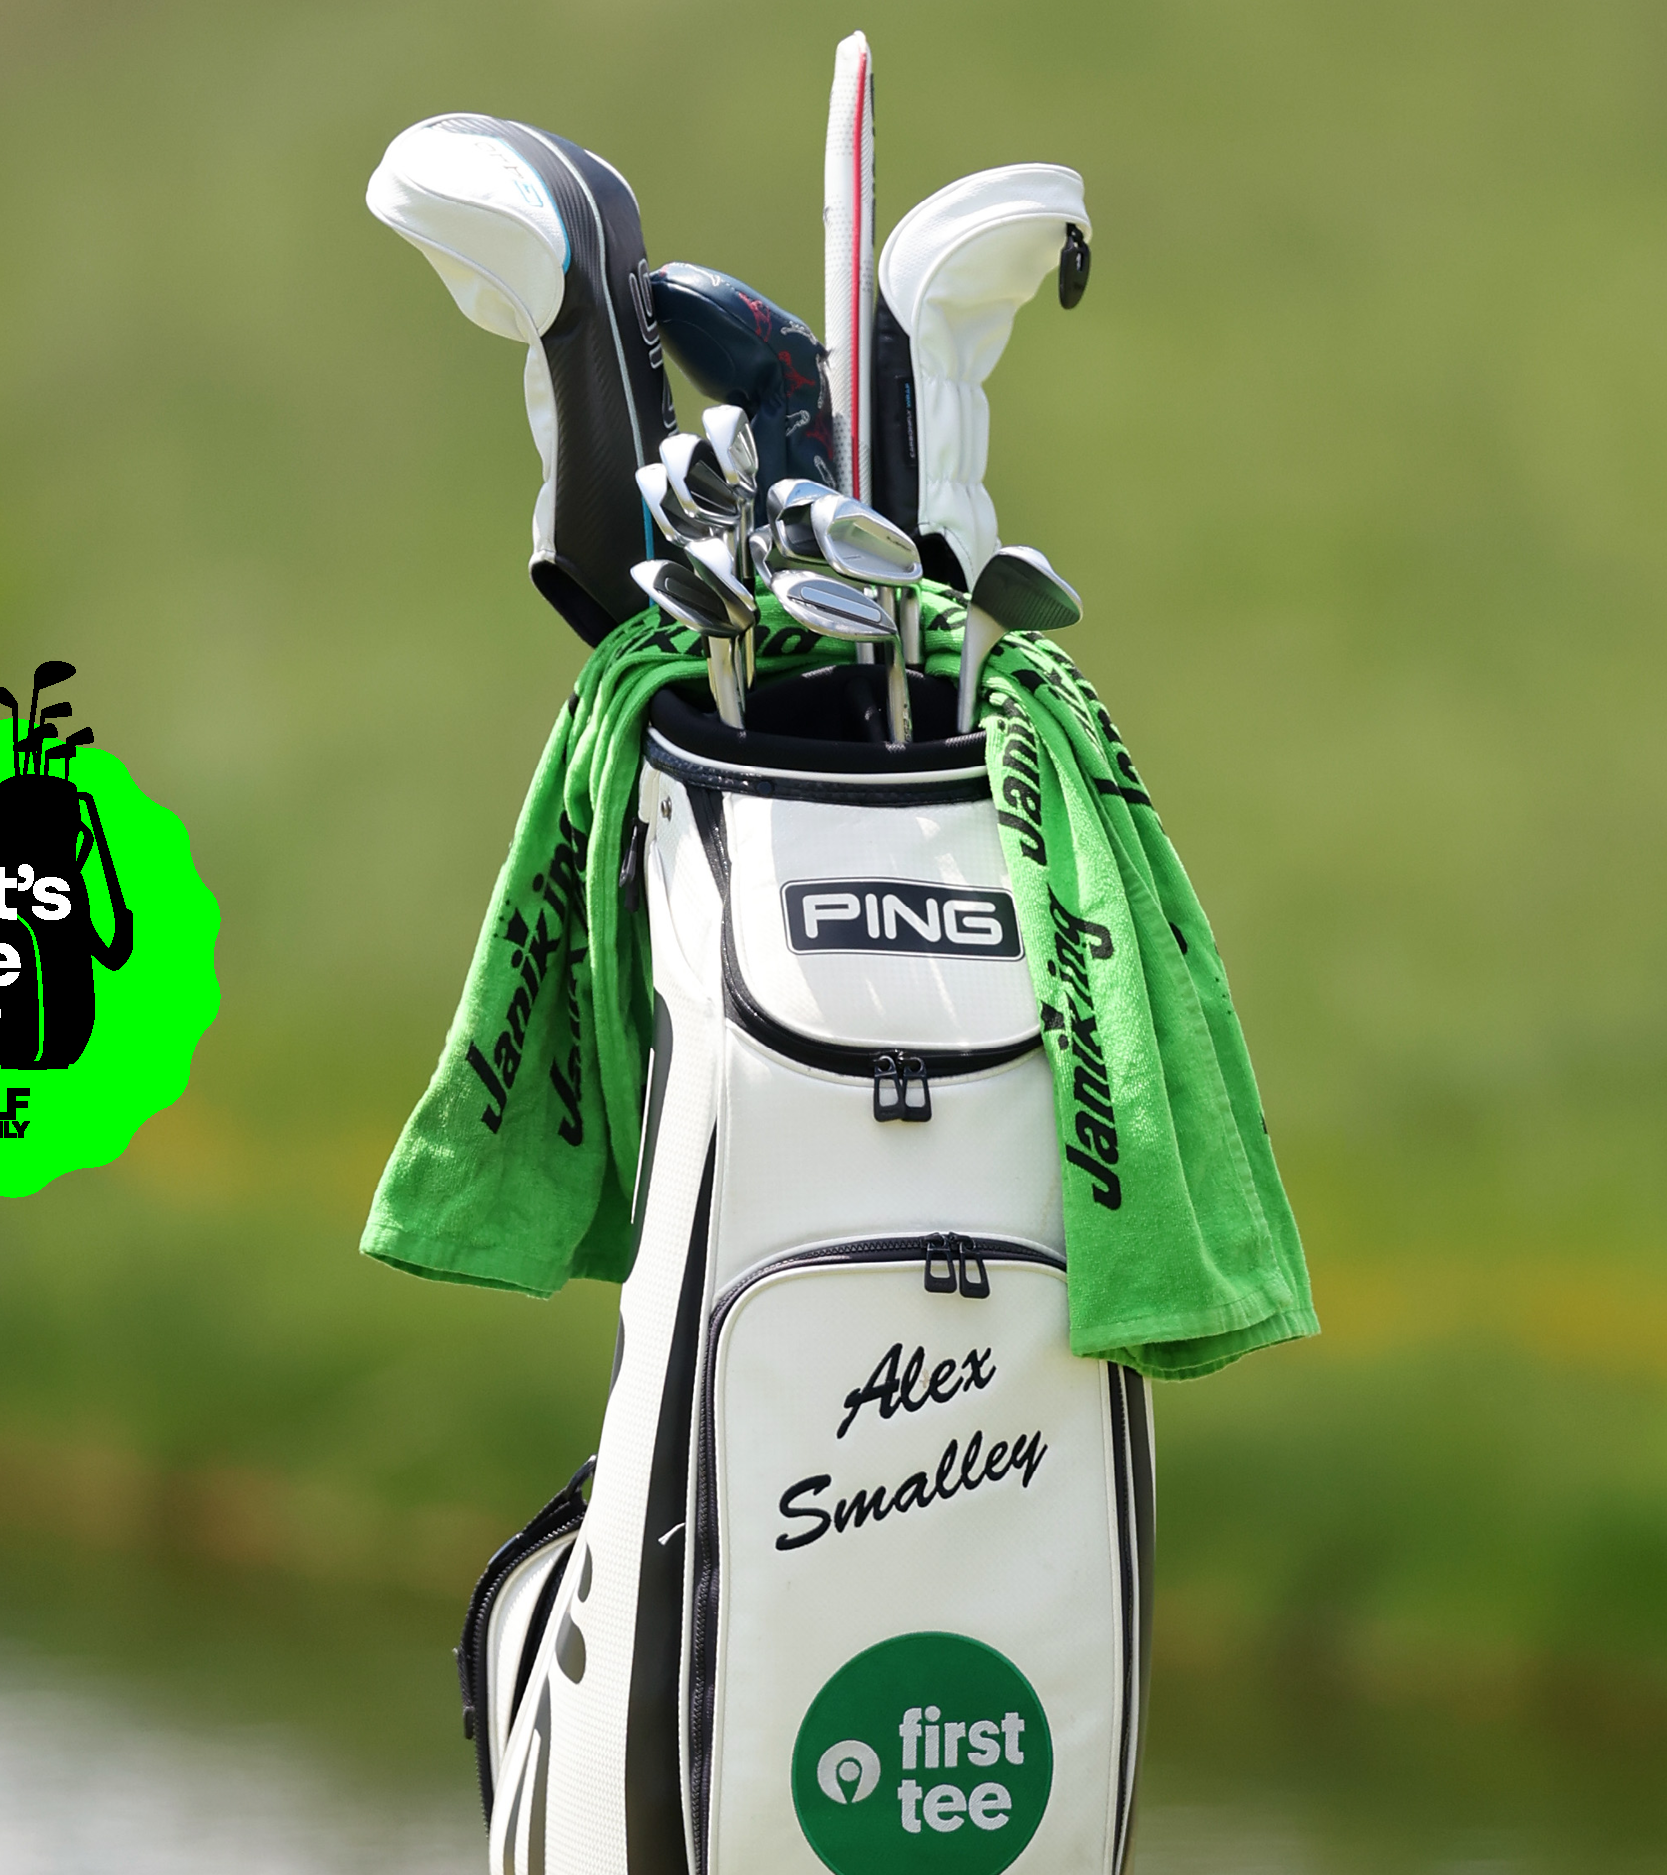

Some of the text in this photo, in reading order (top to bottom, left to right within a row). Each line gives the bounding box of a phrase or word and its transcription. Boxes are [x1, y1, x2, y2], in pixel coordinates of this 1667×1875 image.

[802, 893, 1003, 945] PING
[837, 1343, 996, 1439] Alex
[775, 1430, 1048, 1551] Smalley
[899, 1706, 1025, 1769] first
[898, 1779, 1012, 1833] tee
